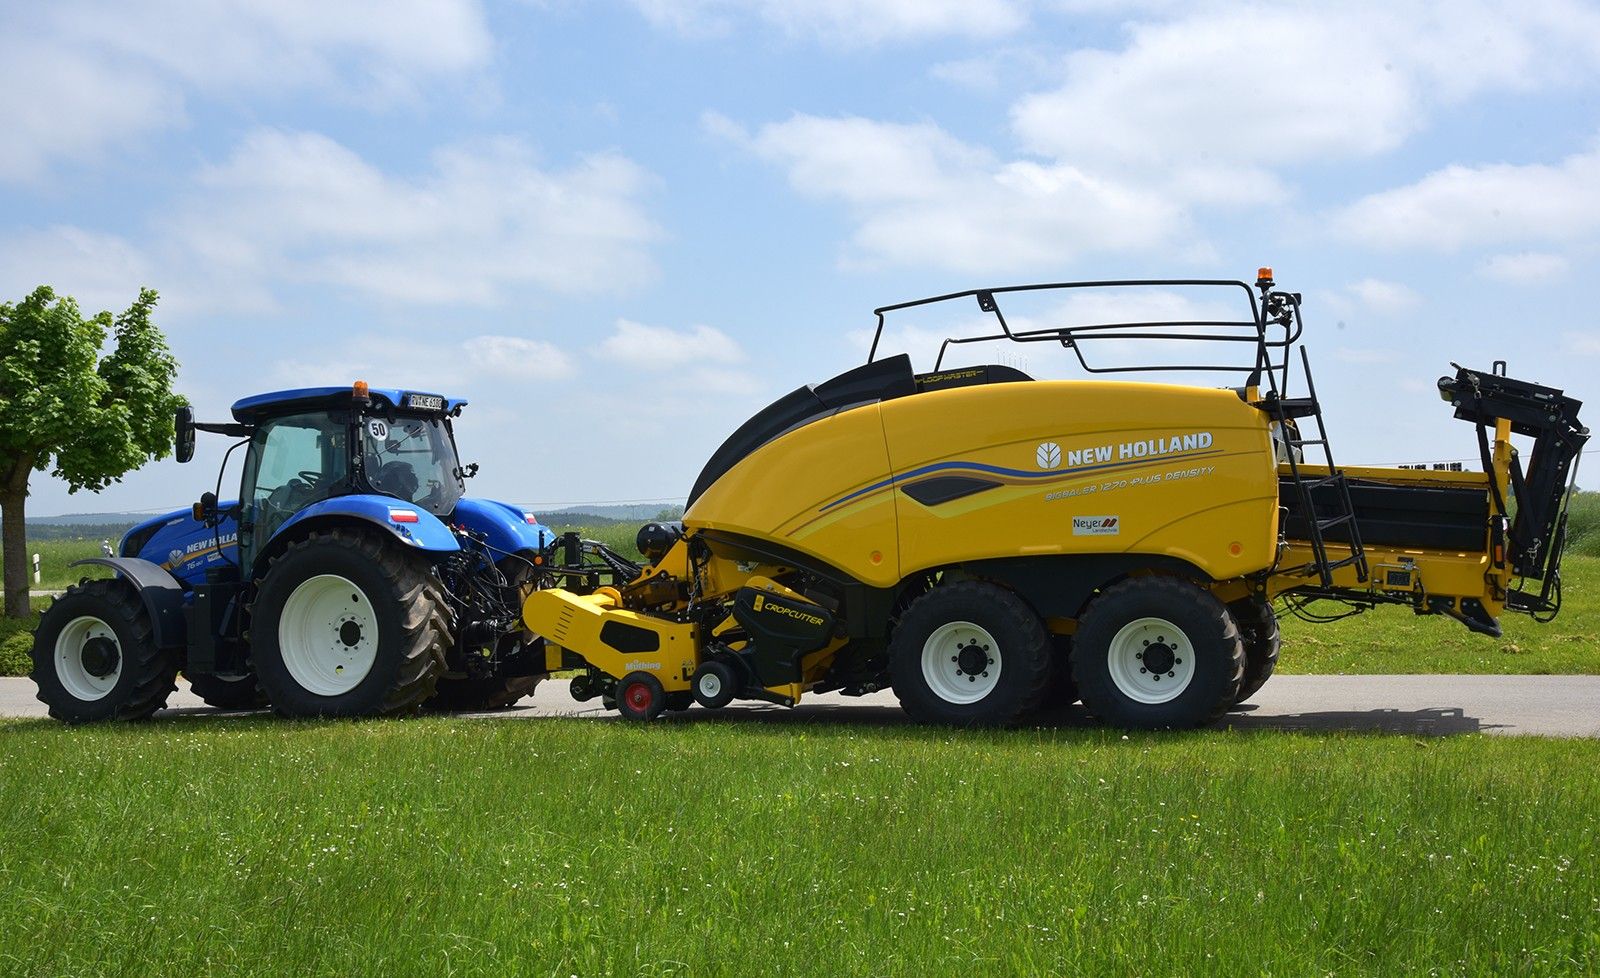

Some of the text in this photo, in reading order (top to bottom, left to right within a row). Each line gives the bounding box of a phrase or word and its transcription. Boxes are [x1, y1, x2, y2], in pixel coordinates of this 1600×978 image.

[371, 423, 386, 437] 50
[1068, 432, 1213, 467] NEW HOLLAND
[1045, 485, 1097, 501] BIGBALER
[1101, 480, 1128, 492] 1270
[1165, 466, 1215, 481] DENSITY
[1073, 518, 1101, 529] Neyer
[186, 532, 238, 554] NEW HLLA
[764, 602, 824, 626] CROPCUTTER
